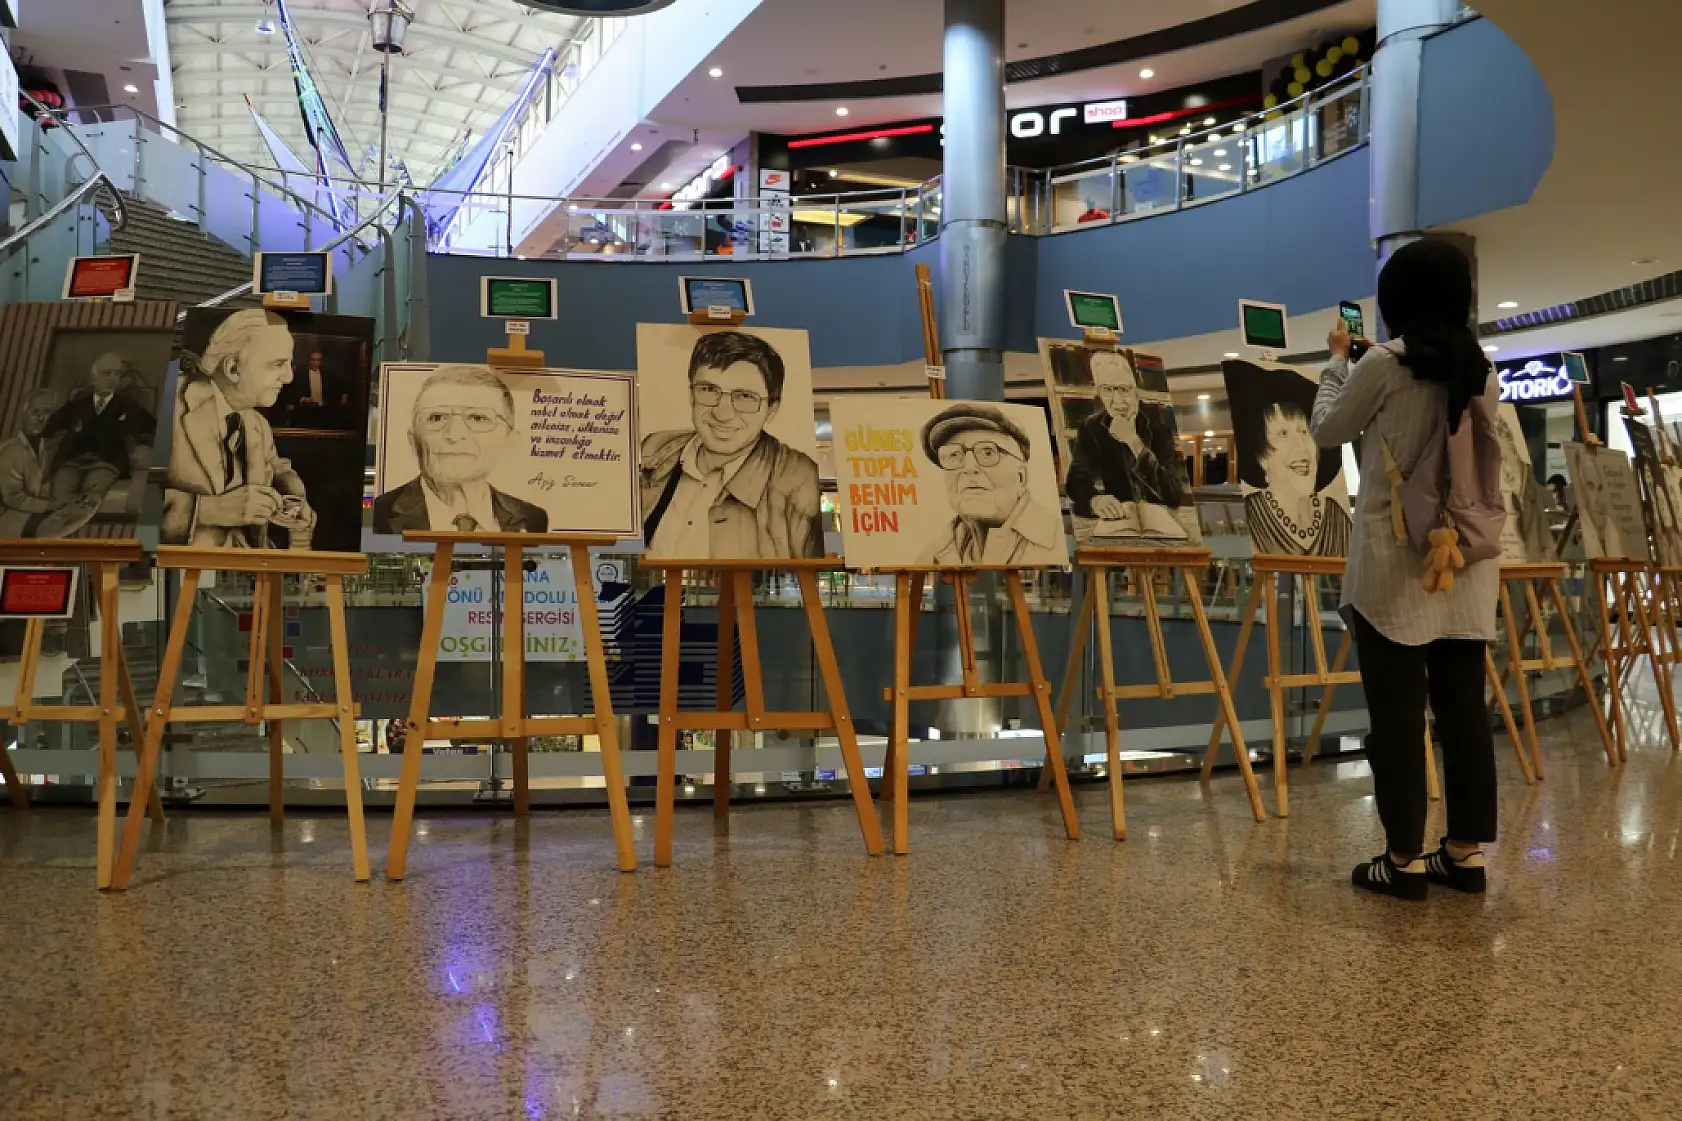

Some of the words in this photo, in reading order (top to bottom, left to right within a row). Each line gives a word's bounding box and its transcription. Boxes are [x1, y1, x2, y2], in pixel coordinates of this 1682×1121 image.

[1087, 105, 1122, 117] shop
[846, 456, 918, 478] TOPLA
[849, 479, 918, 505] BENİM
[851, 506, 899, 536] İÇİN
[447, 586, 482, 603] ÖNÜ
